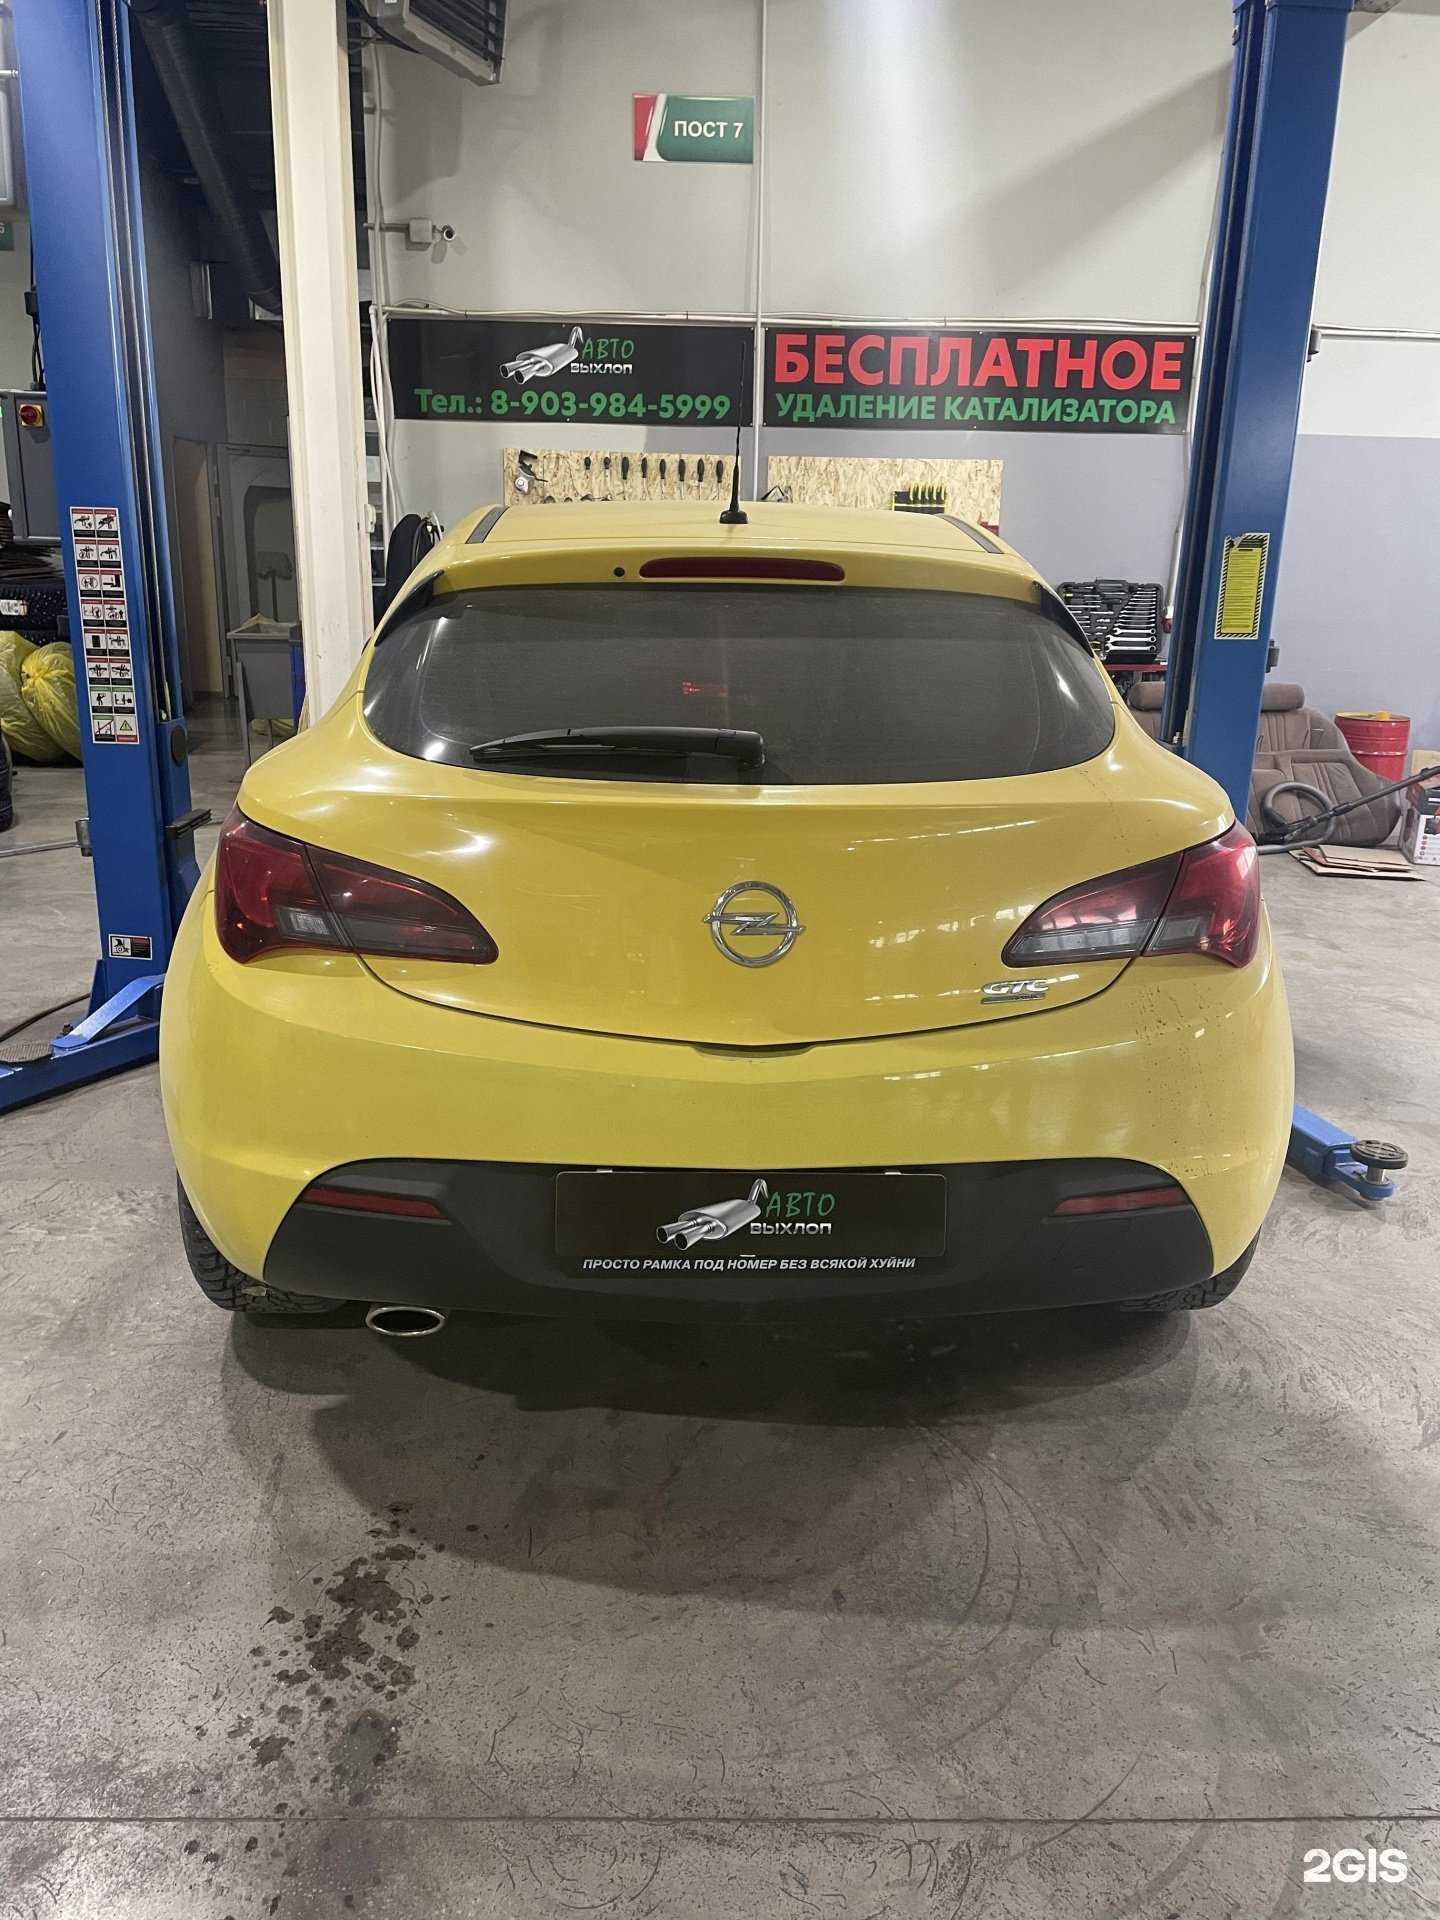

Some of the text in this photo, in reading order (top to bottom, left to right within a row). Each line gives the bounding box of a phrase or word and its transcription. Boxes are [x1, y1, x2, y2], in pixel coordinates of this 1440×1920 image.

[674, 120, 744, 138] ПОСТ 7
[582, 337, 635, 359] АВТО
[571, 362, 633, 375] ВЫХЛОП
[774, 333, 1185, 391] БЕСПЛАТНОЕ
[414, 388, 731, 419] Тел.: 8-903-984-5999
[775, 392, 1177, 425] УДАЛЕНИЕ КАТАЛИЗАТОРА
[981, 979, 1049, 995] GTC
[766, 1191, 837, 1217] АВТО
[750, 1222, 832, 1235] ВЫХЛОП
[582, 1256, 916, 1271] ПРОСТО РАМКА ПОД НОМЕР БЕЗ ВСЯКОЙ ХУЙНИ
